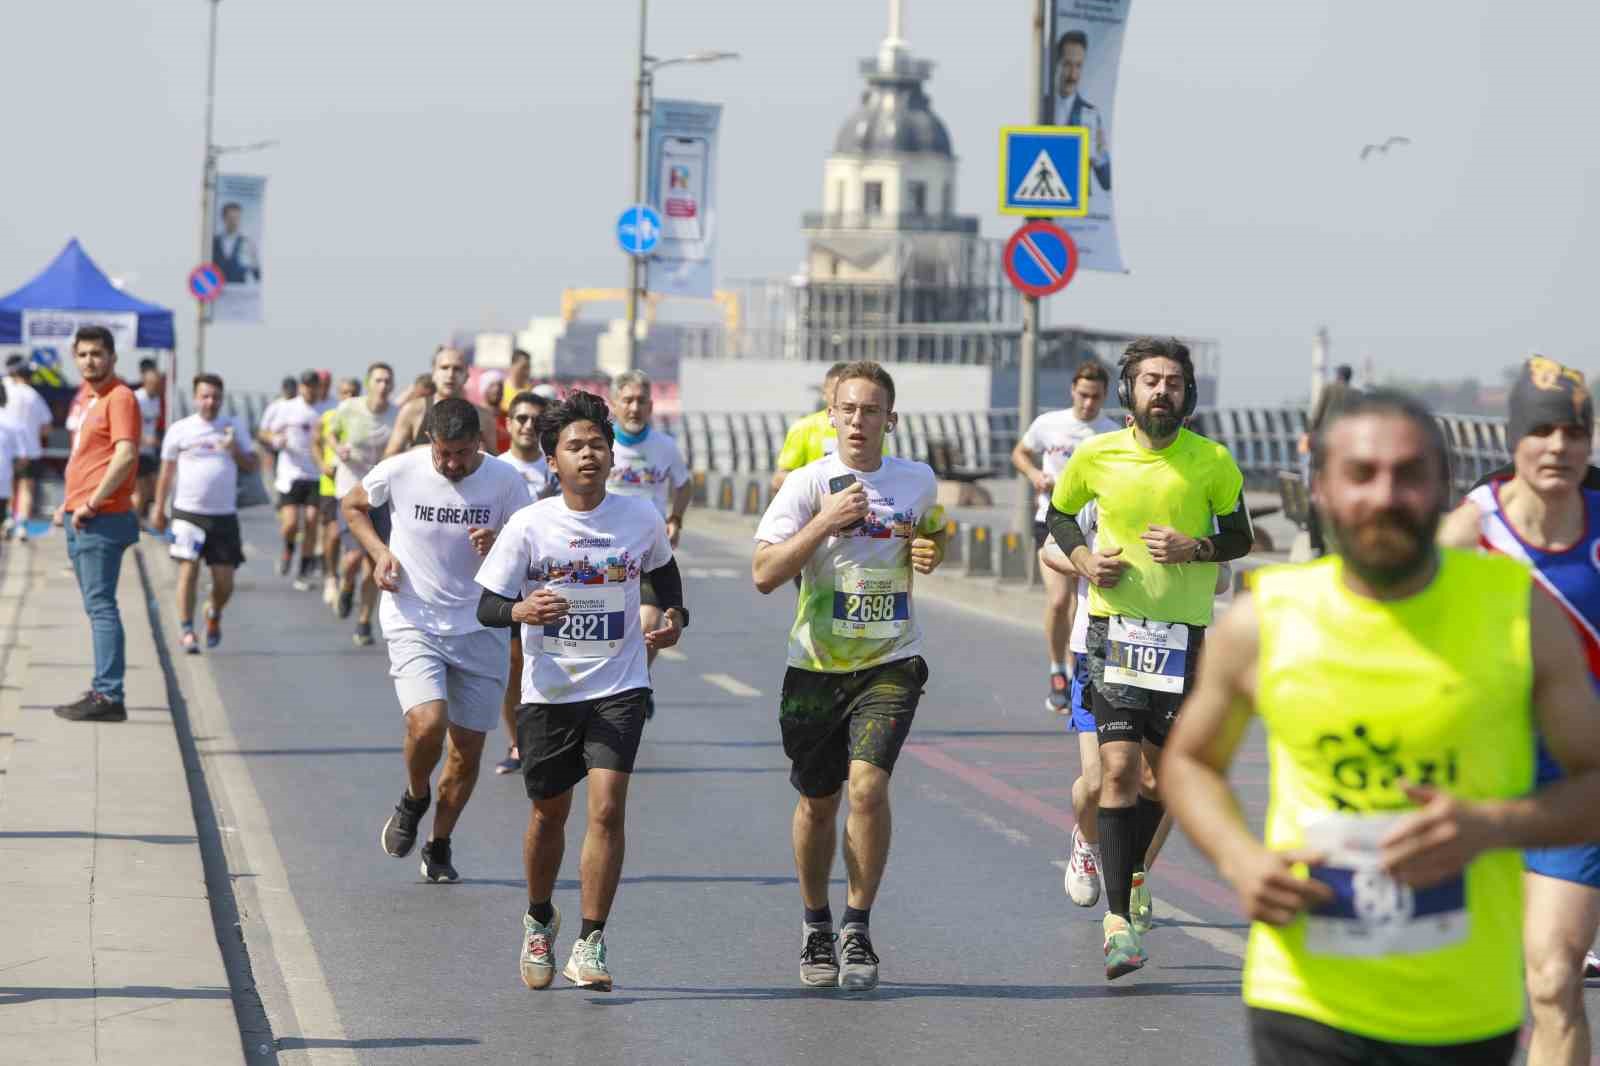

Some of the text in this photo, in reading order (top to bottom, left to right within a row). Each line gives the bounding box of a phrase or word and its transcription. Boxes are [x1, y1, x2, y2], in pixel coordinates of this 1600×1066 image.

[415, 505, 490, 525] THE GREATES
[847, 595, 895, 622] 2698
[558, 614, 609, 640] 2821
[1124, 645, 1170, 674] 1197
